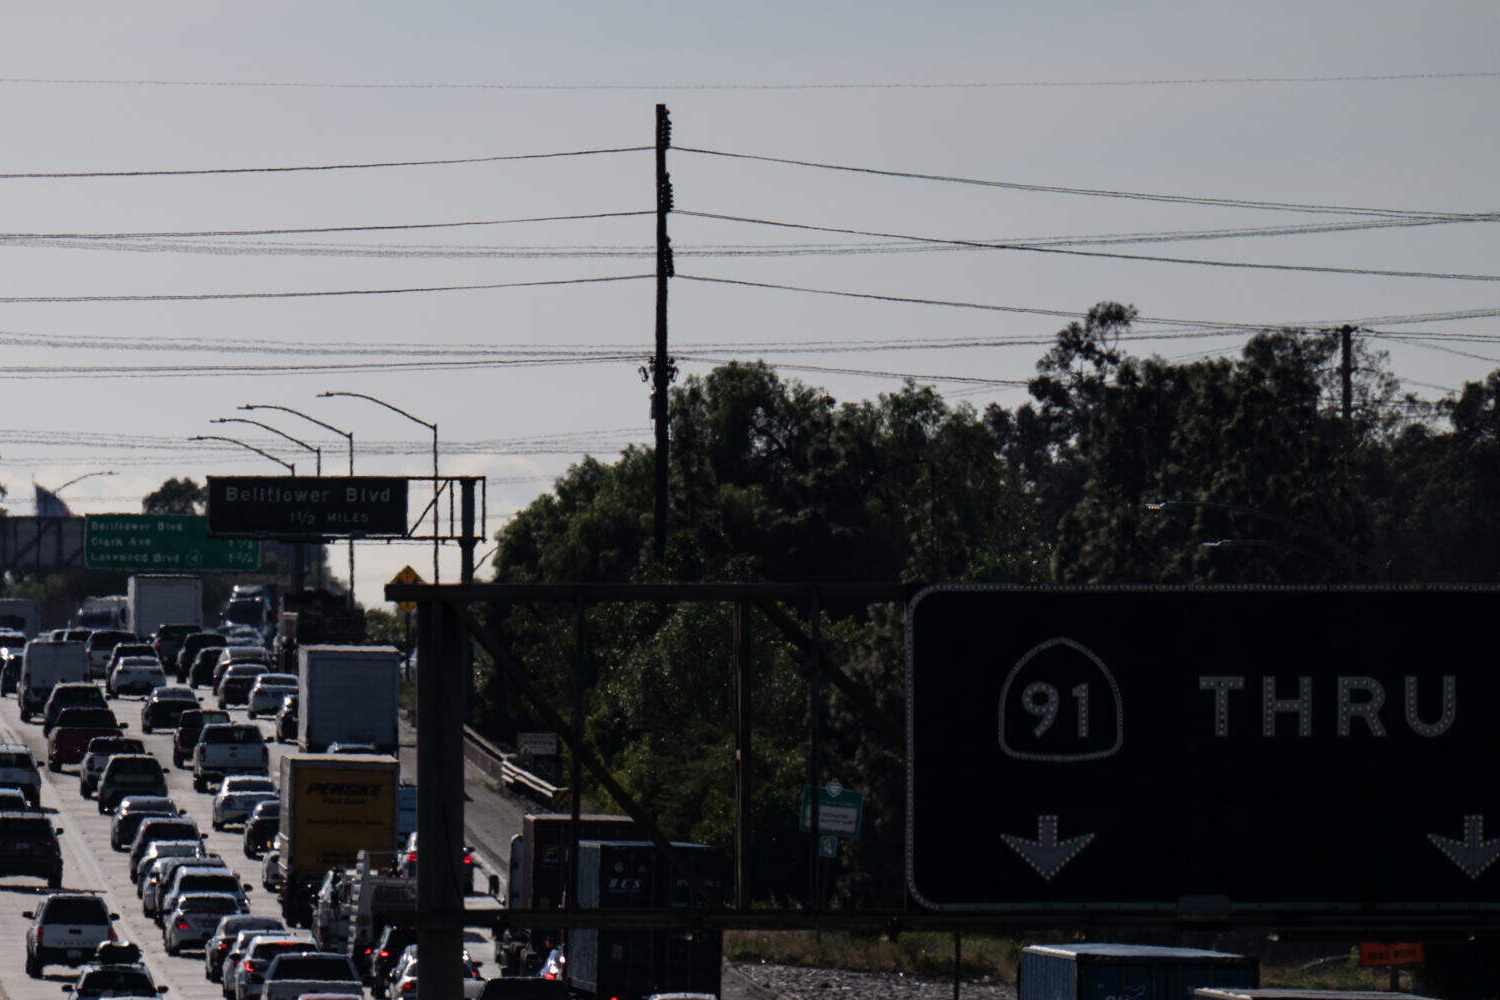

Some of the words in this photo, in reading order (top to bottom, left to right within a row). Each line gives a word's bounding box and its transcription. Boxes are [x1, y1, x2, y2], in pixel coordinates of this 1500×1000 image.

[225, 486, 331, 502] Bellflower
[345, 487, 392, 502] Blvd
[326, 512, 371, 523] MILES
[1020, 680, 1091, 739] 91
[1198, 674, 1457, 739] THRU
[306, 782, 384, 797] PENSKE
